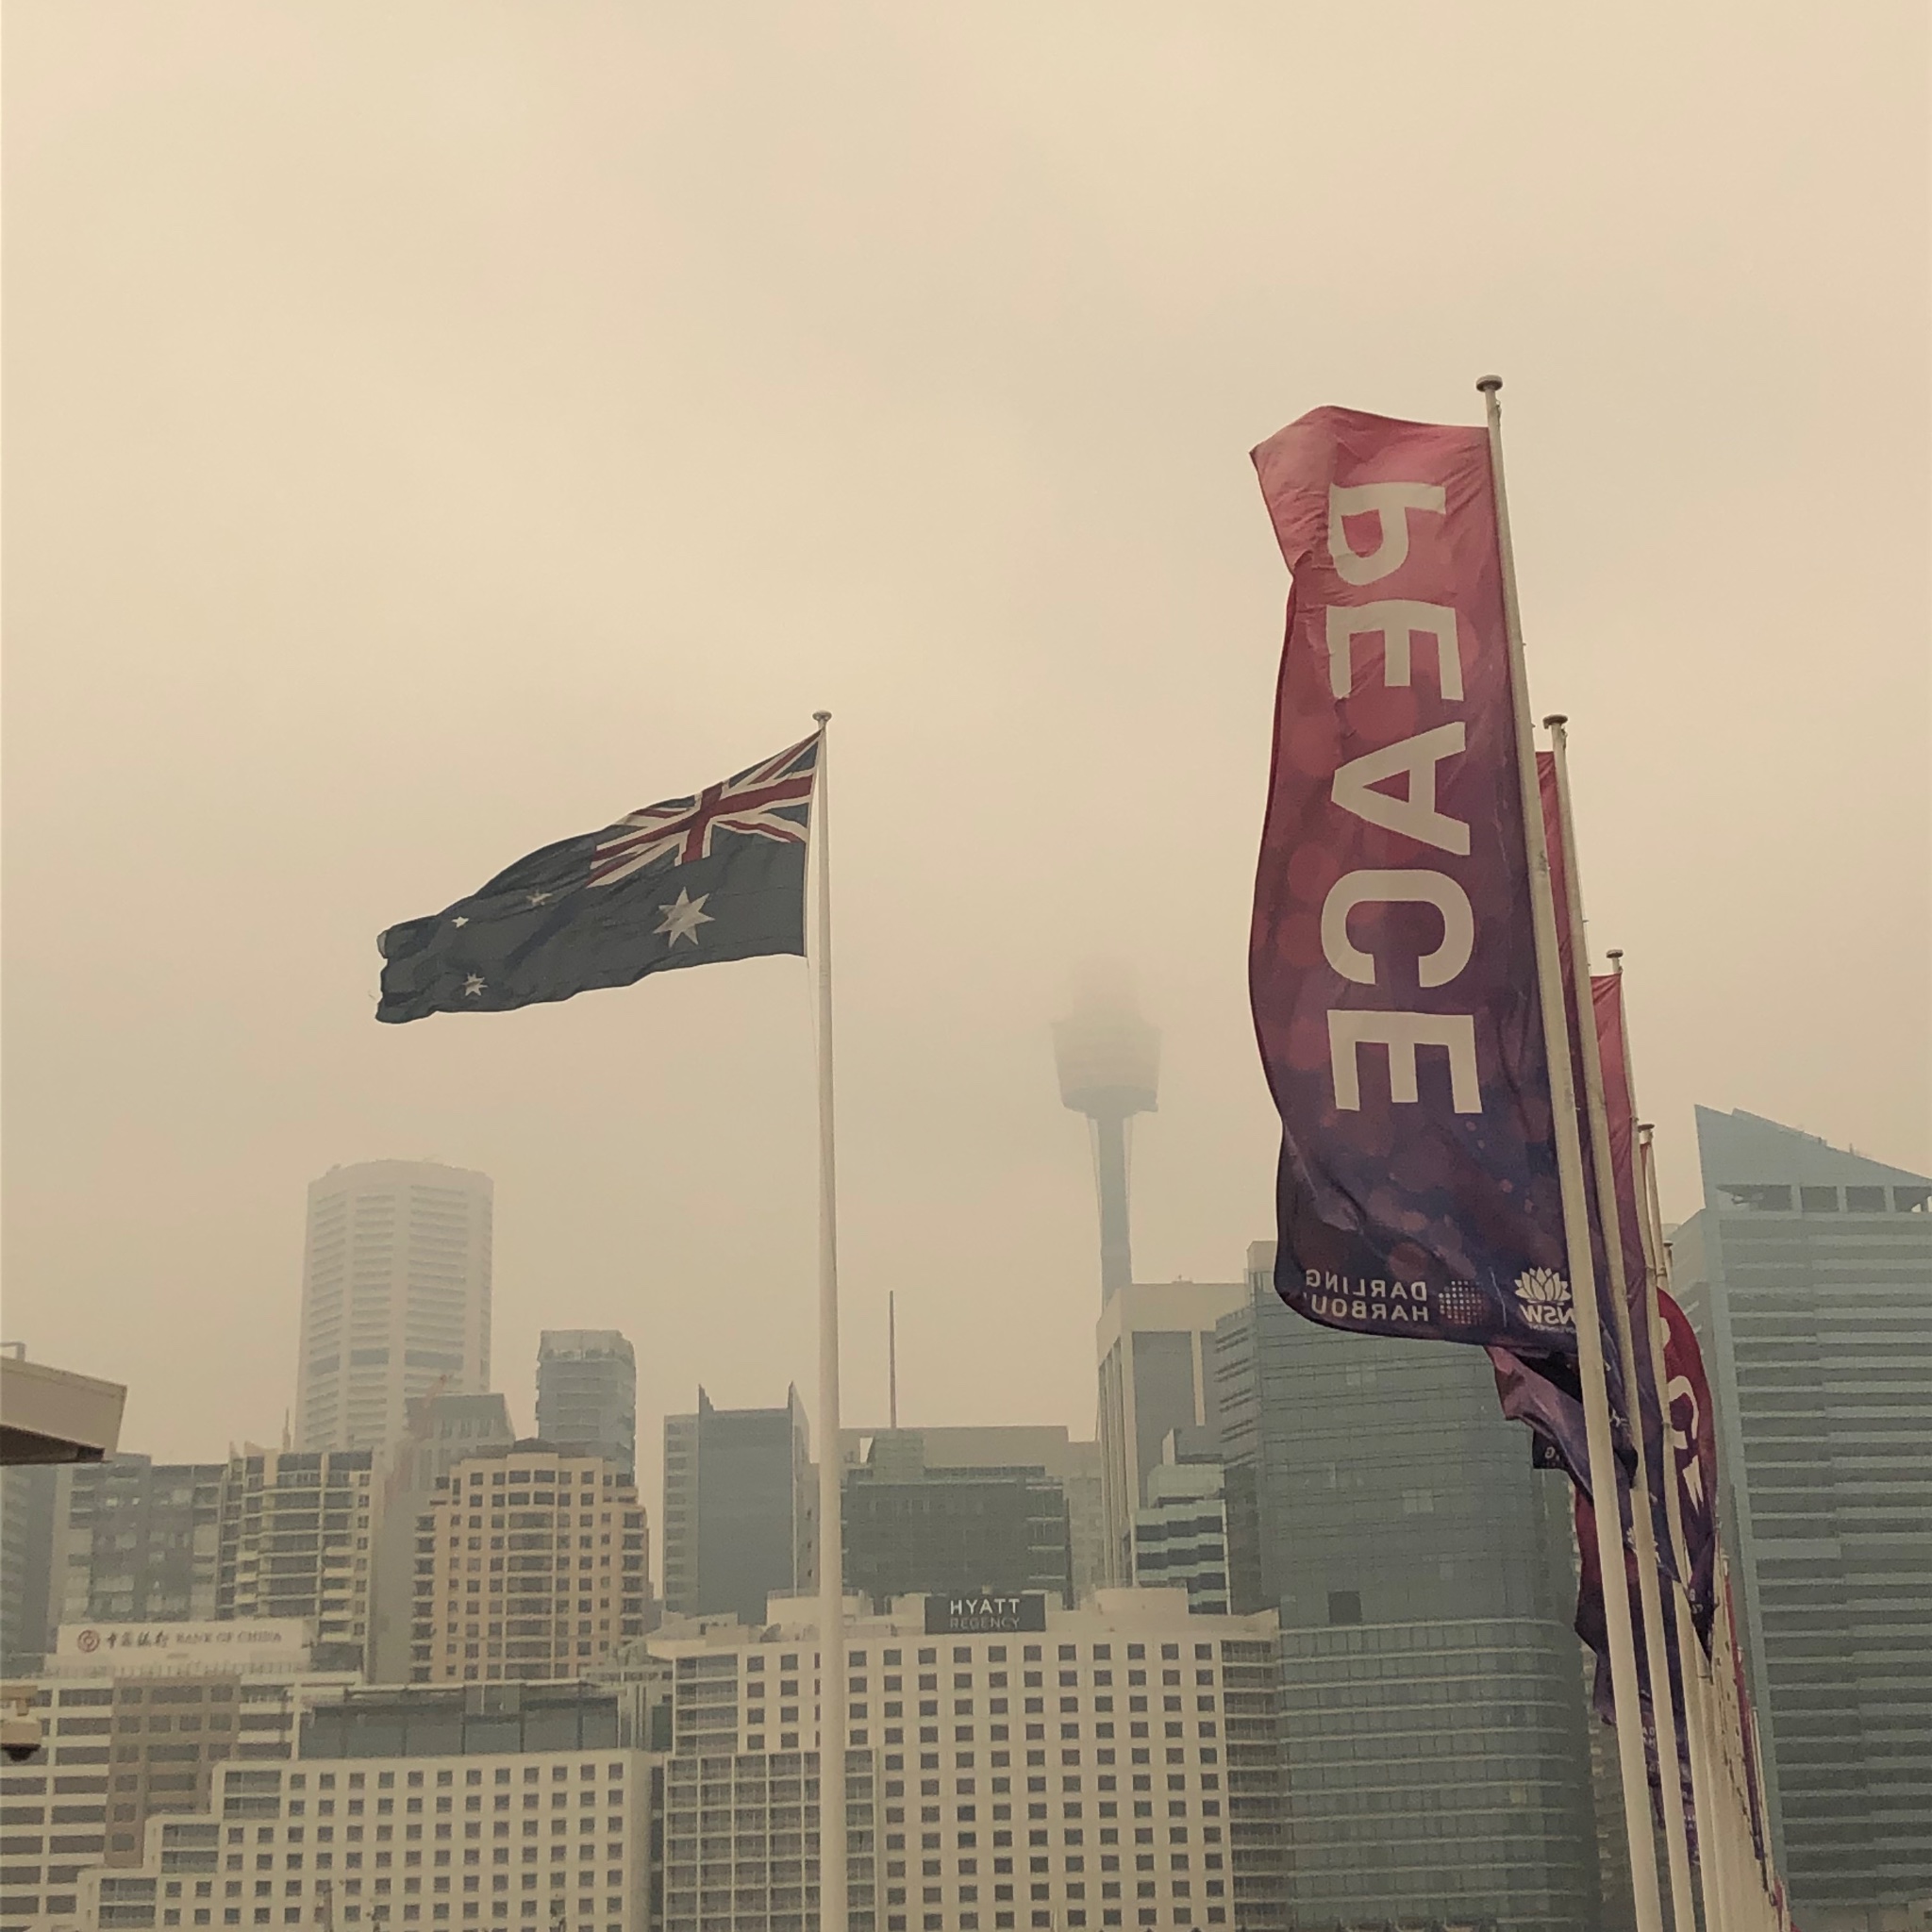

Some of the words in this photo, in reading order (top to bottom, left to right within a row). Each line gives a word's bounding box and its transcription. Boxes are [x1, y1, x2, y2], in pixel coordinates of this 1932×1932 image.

[950, 1598, 1020, 1614] HYATT
[950, 1617, 1019, 1629] REGENCY
[216, 1632, 232, 1643] OF
[238, 1631, 282, 1643] CHINA
